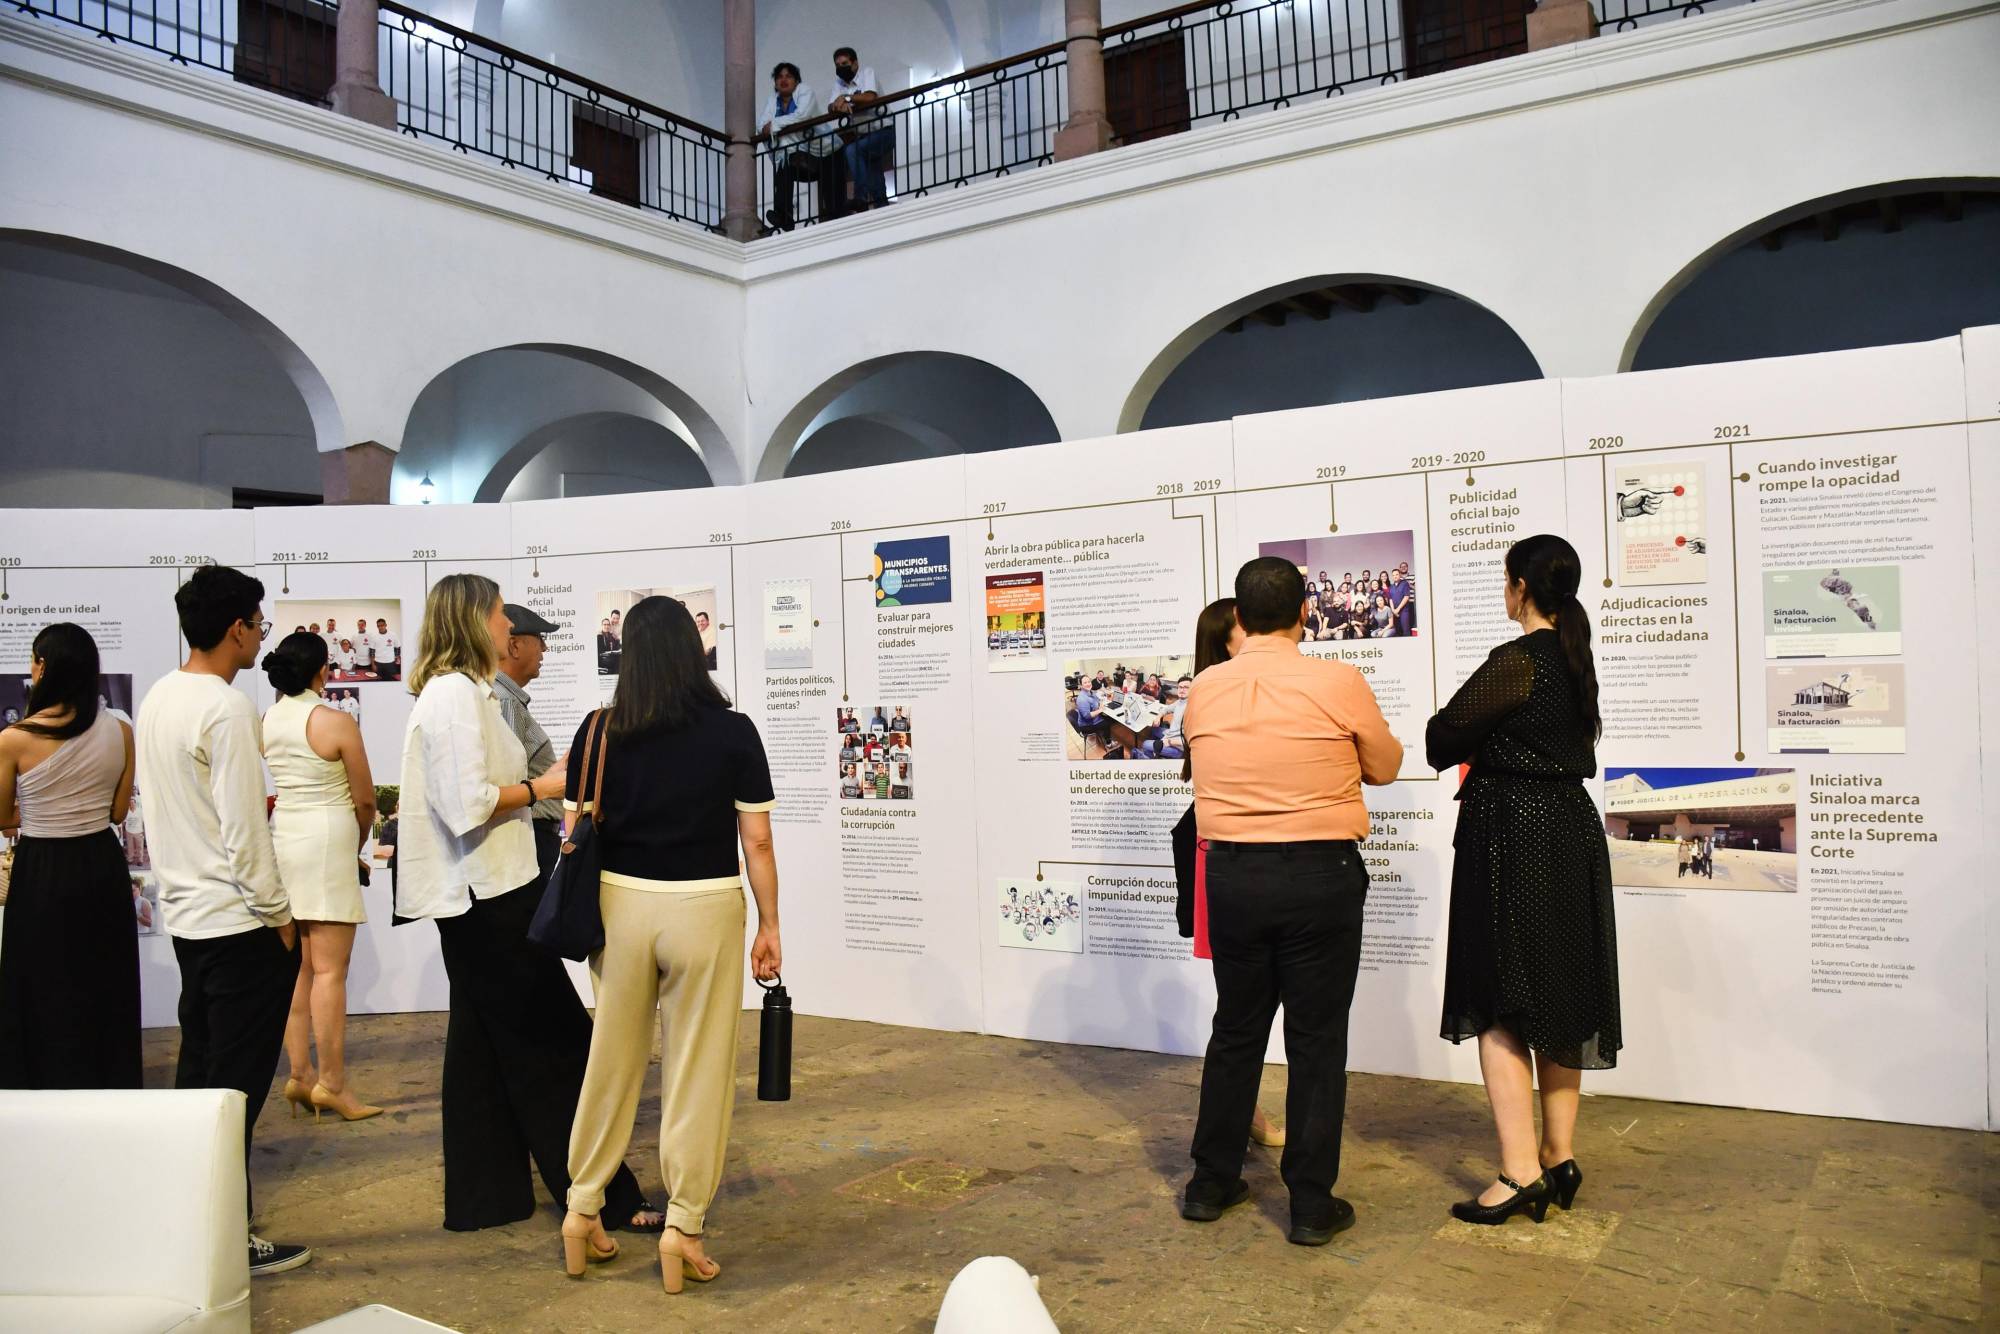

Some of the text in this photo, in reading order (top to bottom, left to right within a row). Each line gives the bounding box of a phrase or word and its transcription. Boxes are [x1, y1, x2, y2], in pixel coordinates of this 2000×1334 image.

[1714, 425, 1750, 439] 2021
[1589, 436, 1624, 450] 2020
[1412, 455, 1442, 469] 2019
[1453, 450, 1486, 464] 2020
[1758, 453, 1897, 474] Cuando investigar
[1316, 466, 1346, 479] 2019
[1193, 479, 1221, 492] 2019
[1759, 470, 1900, 494] rompe la opacidad
[1156, 483, 1184, 495] 2018
[1450, 488, 1517, 505] Publicidad
[984, 502, 1006, 514] 2017
[1450, 504, 1520, 521] oficial bajo
[830, 520, 852, 530] 2016
[1451, 522, 1515, 536] escrutinio
[710, 533, 732, 542] 2015
[985, 533, 1145, 556] Abrir la obra pública para hacerla
[150, 555, 175, 564] 2010
[184, 555, 210, 564] 2012
[305, 552, 328, 561] 2012
[412, 550, 437, 558] 2013
[985, 551, 1109, 569] verdaderamente... pública
[0, 558, 21, 566] 010
[884, 558, 928, 568] MUNICIPIOS
[527, 584, 572, 595] Publicidad
[528, 596, 553, 607] oficial
[1601, 596, 1708, 612] Adjudicaciones
[7, 605, 41, 616] origen
[43, 605, 56, 614] de
[75, 604, 100, 613] ideal
[558, 608, 575, 618] lupa
[878, 612, 931, 623] Evaluar para
[1601, 613, 1693, 627] directas en la
[878, 623, 953, 635] construir mejores
[545, 633, 574, 641] rimera
[878, 638, 916, 648] ciudades
[1602, 630, 1708, 644] mira ciudadana
[546, 644, 585, 654] stigación
[1342, 649, 1358, 659] los
[1361, 648, 1383, 658] seis
[766, 675, 834, 686] Partidos políticos,
[767, 687, 826, 700] ¿quiénes rinden
[767, 701, 800, 710] cuentas?
[1070, 770, 1111, 780] Libertad
[1117, 770, 1126, 780] de
[1810, 773, 1882, 787] Iniciativa
[1085, 784, 1125, 794] derecho
[1128, 787, 1146, 796] que
[1810, 791, 1920, 806] Sinaloa marca
[1368, 809, 1434, 821] nsparencia
[1811, 810, 1924, 828] un precedente
[841, 819, 895, 831] la corrupción
[1370, 824, 1397, 835] de la
[1811, 827, 1938, 846] ante la Suprema
[1811, 845, 1855, 859] Corte
[1088, 876, 1144, 888] Corrupción
[1371, 872, 1401, 882] casin
[1088, 889, 1141, 901] impunidad
